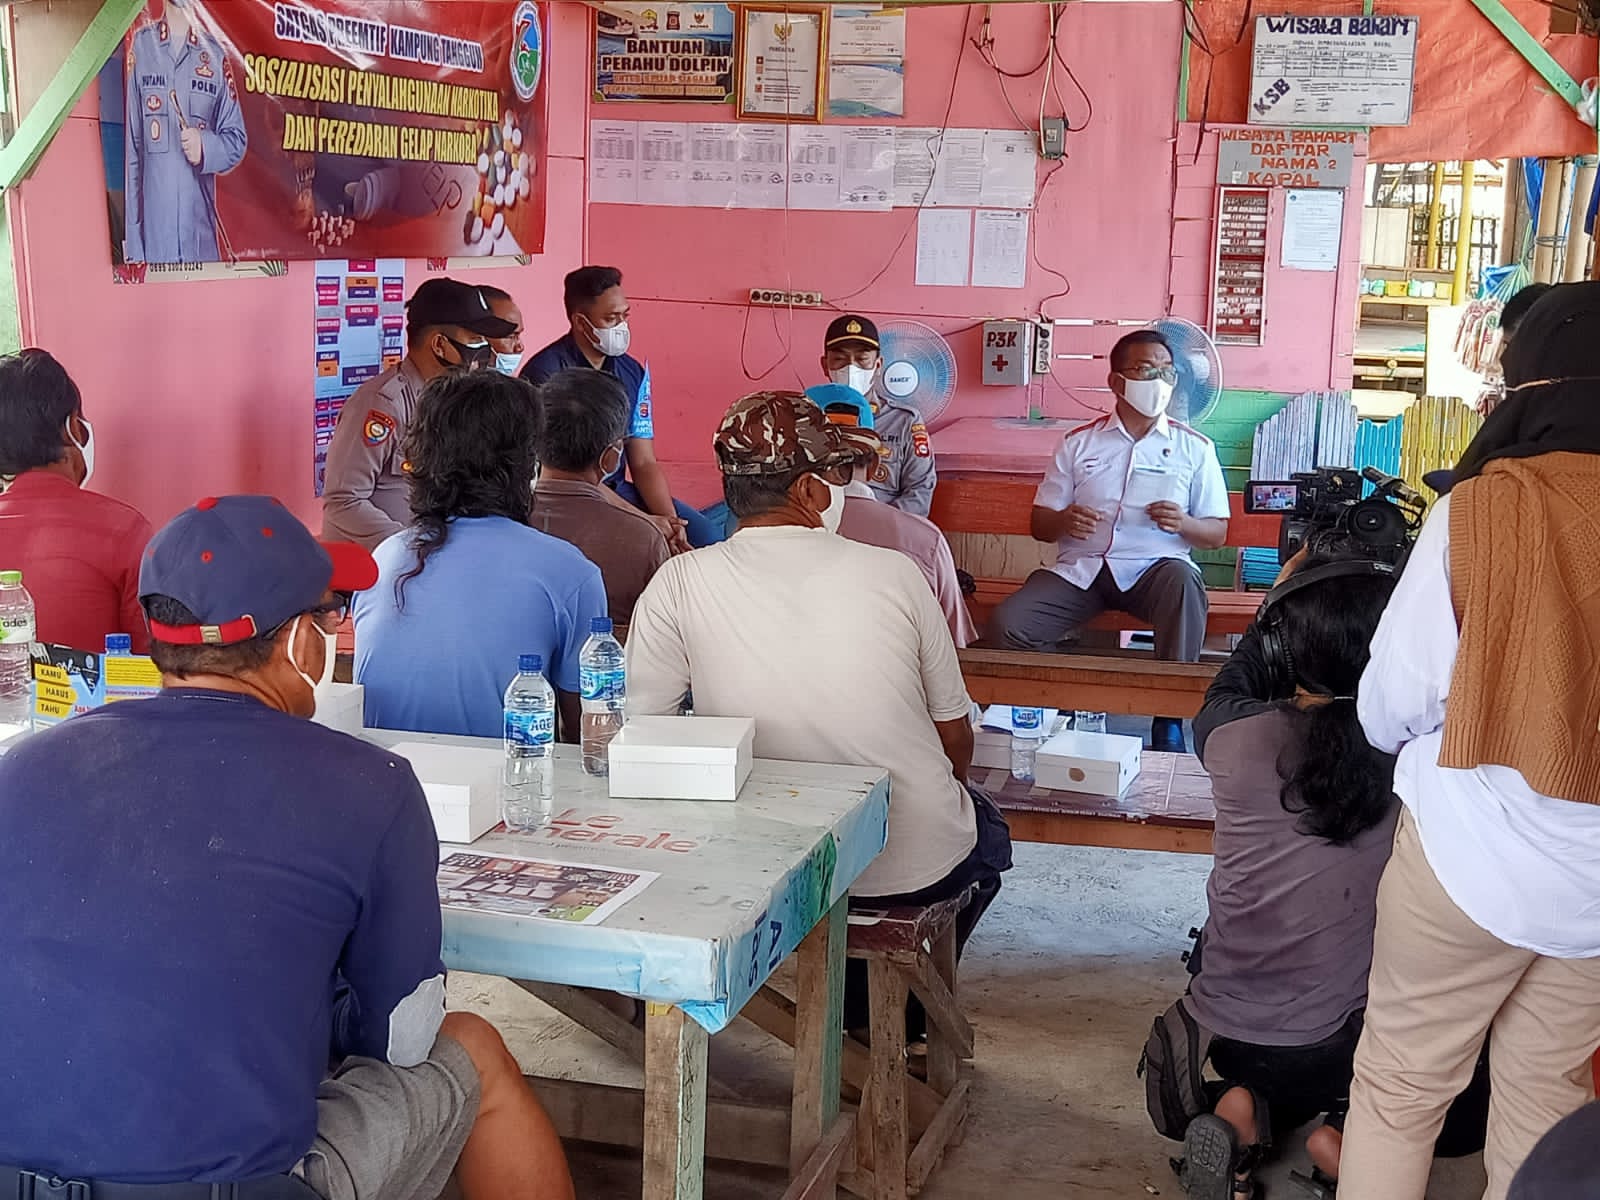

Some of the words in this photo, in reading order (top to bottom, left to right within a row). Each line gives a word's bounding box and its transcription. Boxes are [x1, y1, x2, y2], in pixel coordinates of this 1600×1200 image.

[390, 26, 440, 62] KAMPUNG
[626, 40, 702, 54] BANTUAN
[602, 56, 665, 71] PERAHU
[669, 57, 728, 72] DOLPIN
[191, 79, 217, 95] POLRI
[244, 55, 344, 104] SOSIALISASI
[348, 70, 450, 115] PENYALAHGUNAAN
[1253, 78, 1291, 116] KSB
[283, 113, 315, 151] DAN
[318, 118, 399, 159] PEREDARAN
[401, 127, 433, 161] GELAP
[434, 130, 478, 165] NARKOBA
[1251, 143, 1329, 156] DAFTAR
[1261, 158, 1319, 169] NAMA
[1247, 172, 1320, 186] KAPAL
[986, 331, 1017, 348] P3K
[41, 668, 62, 679] KAMU
[41, 704, 60, 714] TAHU
